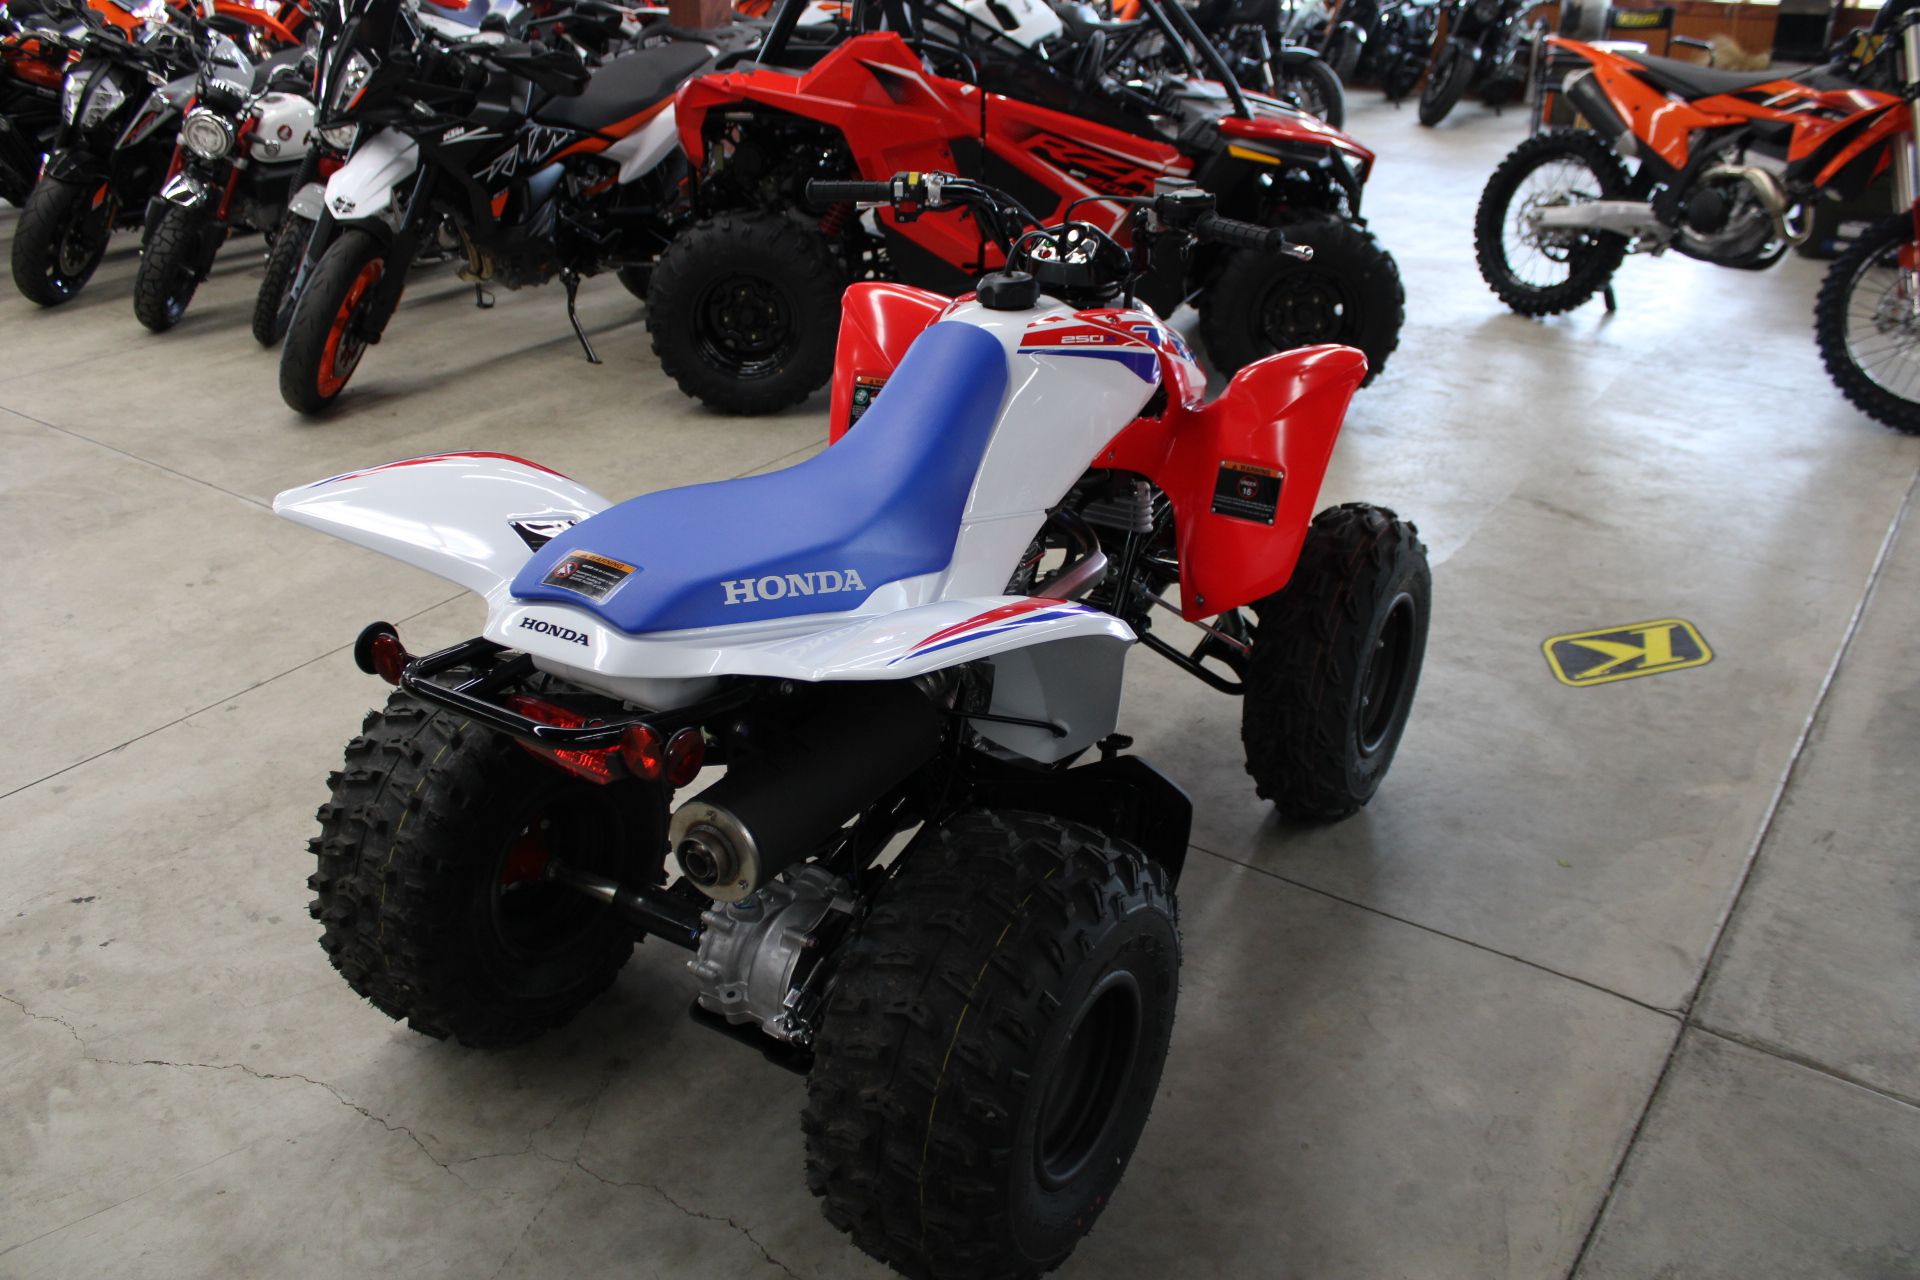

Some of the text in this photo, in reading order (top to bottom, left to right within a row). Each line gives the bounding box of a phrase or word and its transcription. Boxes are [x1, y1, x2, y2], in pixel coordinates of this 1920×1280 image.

[1243, 487, 1252, 496] 16
[589, 555, 625, 569] WARNING
[720, 569, 866, 605] HONDA
[519, 616, 590, 646] HONDA
